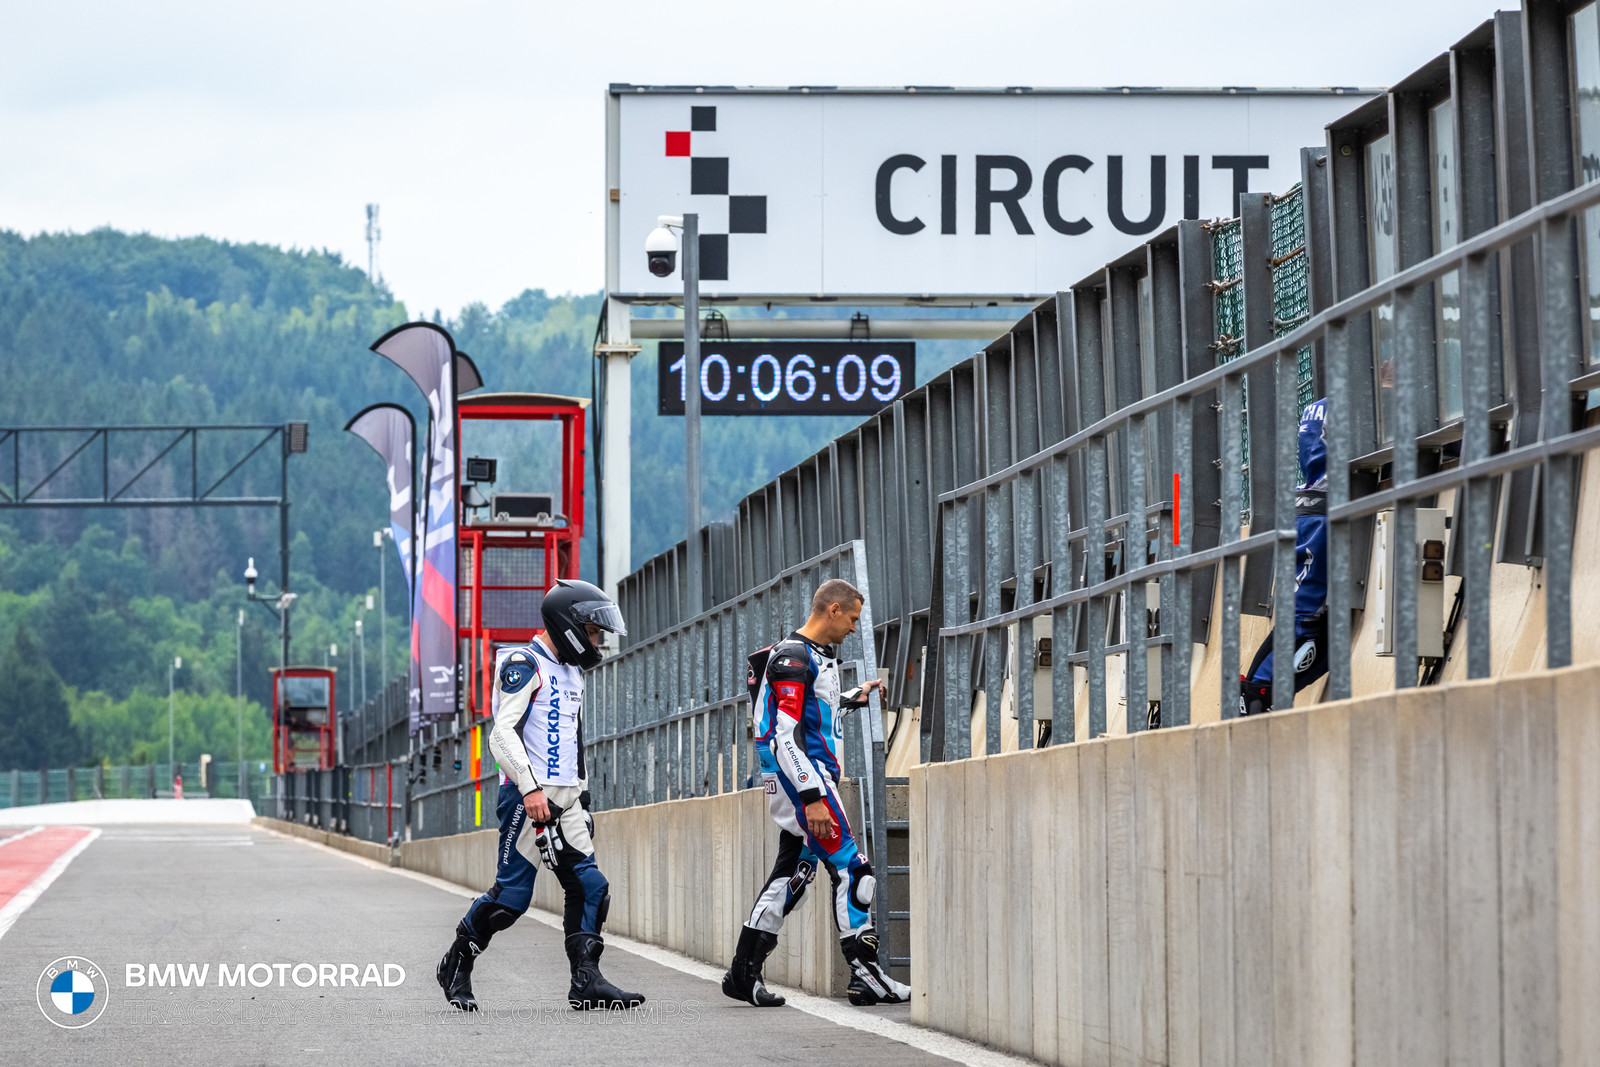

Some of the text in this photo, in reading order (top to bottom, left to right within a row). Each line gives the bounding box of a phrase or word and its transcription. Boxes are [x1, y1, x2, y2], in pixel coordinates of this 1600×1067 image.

[875, 152, 1269, 236] CIRCUIT
[669, 354, 902, 401] 10:06:09
[547, 675, 560, 779] TRACKDAYS
[784, 740, 803, 773] E.Leclerc
[503, 803, 525, 865] BMW Motorrad
